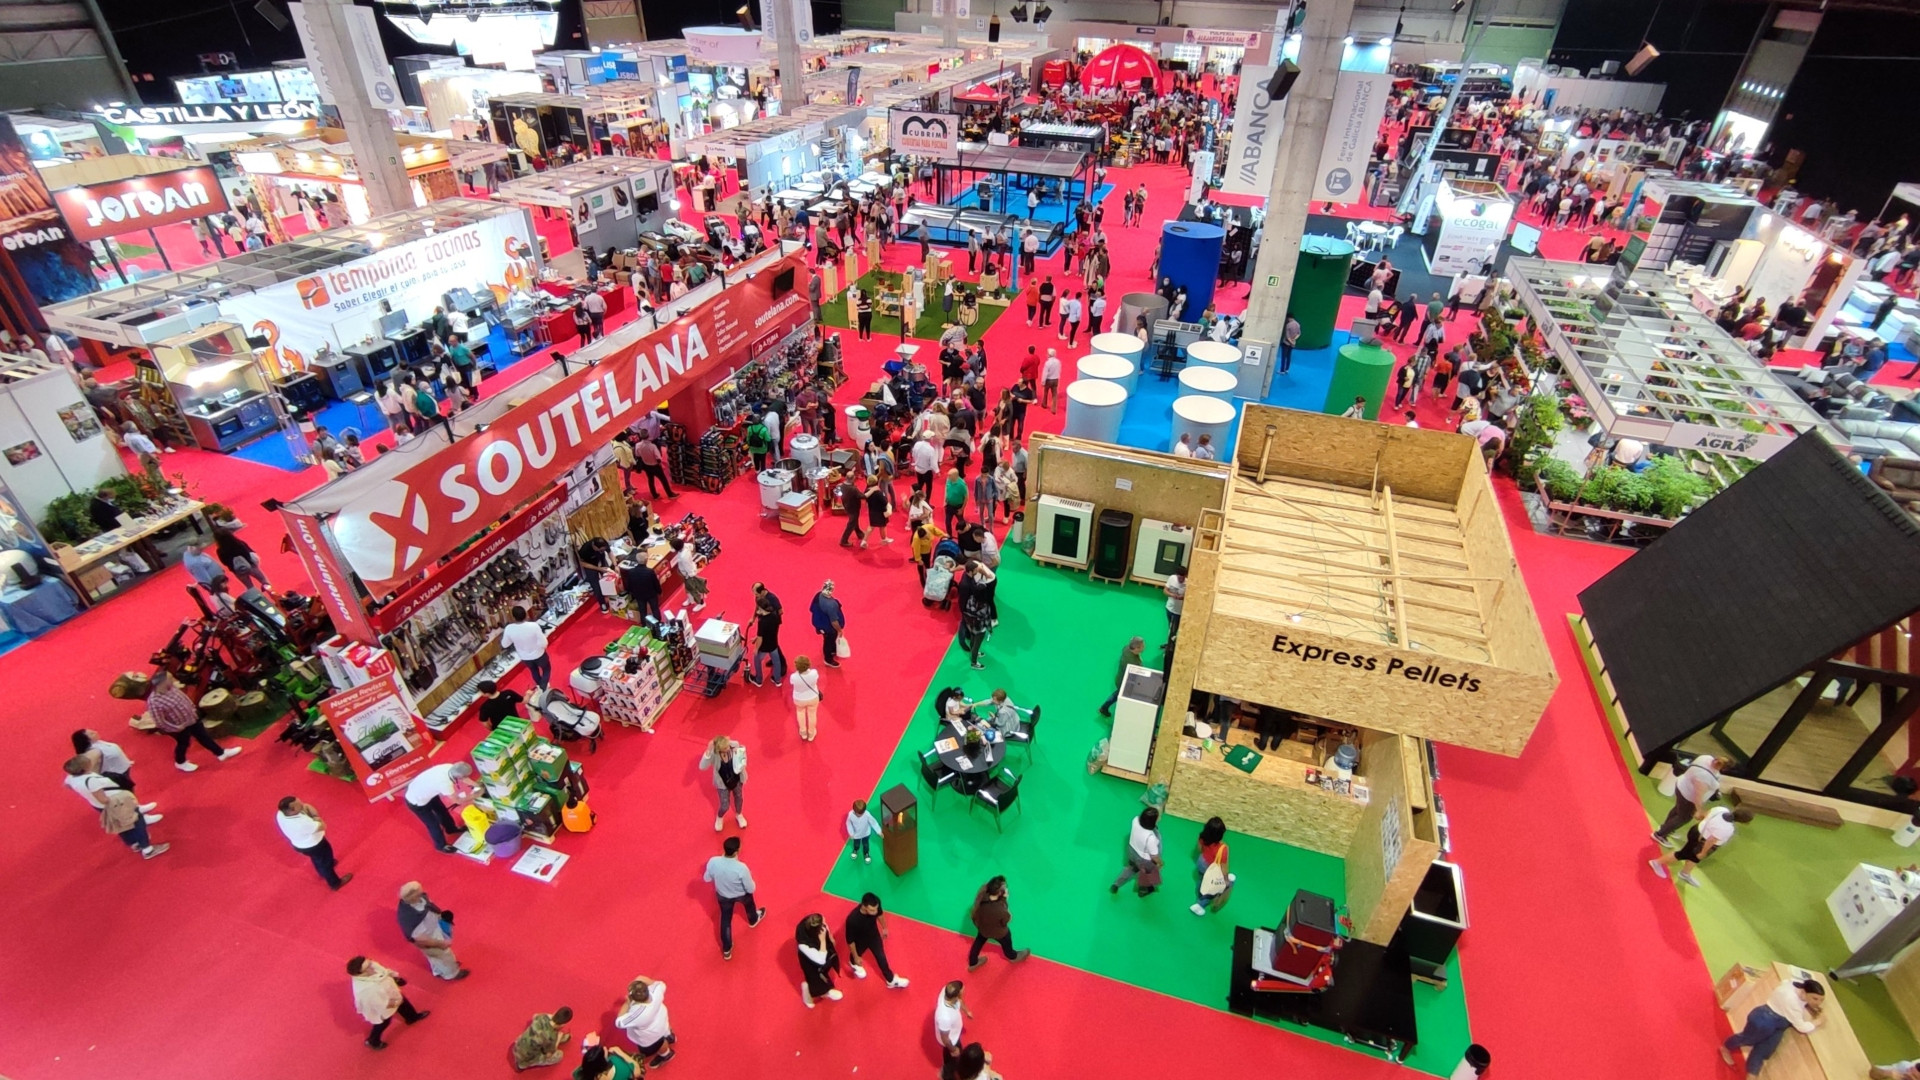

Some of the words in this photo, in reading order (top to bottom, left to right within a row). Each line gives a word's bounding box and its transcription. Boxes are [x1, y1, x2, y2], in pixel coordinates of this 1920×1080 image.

[587, 66, 604, 75] LISBOA
[616, 71, 639, 80] LISBOA
[104, 103, 234, 125] CASTILLA
[234, 105, 250, 121] Y
[253, 99, 318, 121] LEÓN
[1359, 80, 1374, 121] ABANCA
[1337, 140, 1348, 162] Feira
[1344, 80, 1364, 138] Internacional
[1348, 120, 1361, 151] Galicia
[1345, 153, 1355, 162] de
[334, 298, 360, 312] Saber
[754, 293, 800, 329] soutelana.com
[440, 323, 709, 523] SOUTELANA
[536, 497, 560, 517] A.YUMA
[479, 536, 506, 559] A.YUMA
[296, 518, 354, 623] soutelana.com
[412, 582, 443, 607] A.YUMA
[1271, 634, 1378, 671] Express
[1385, 657, 1482, 692] Pellets
[330, 693, 358, 709] Nueva
[359, 680, 387, 696] Revista
[385, 757, 424, 778] SOUTELANA
